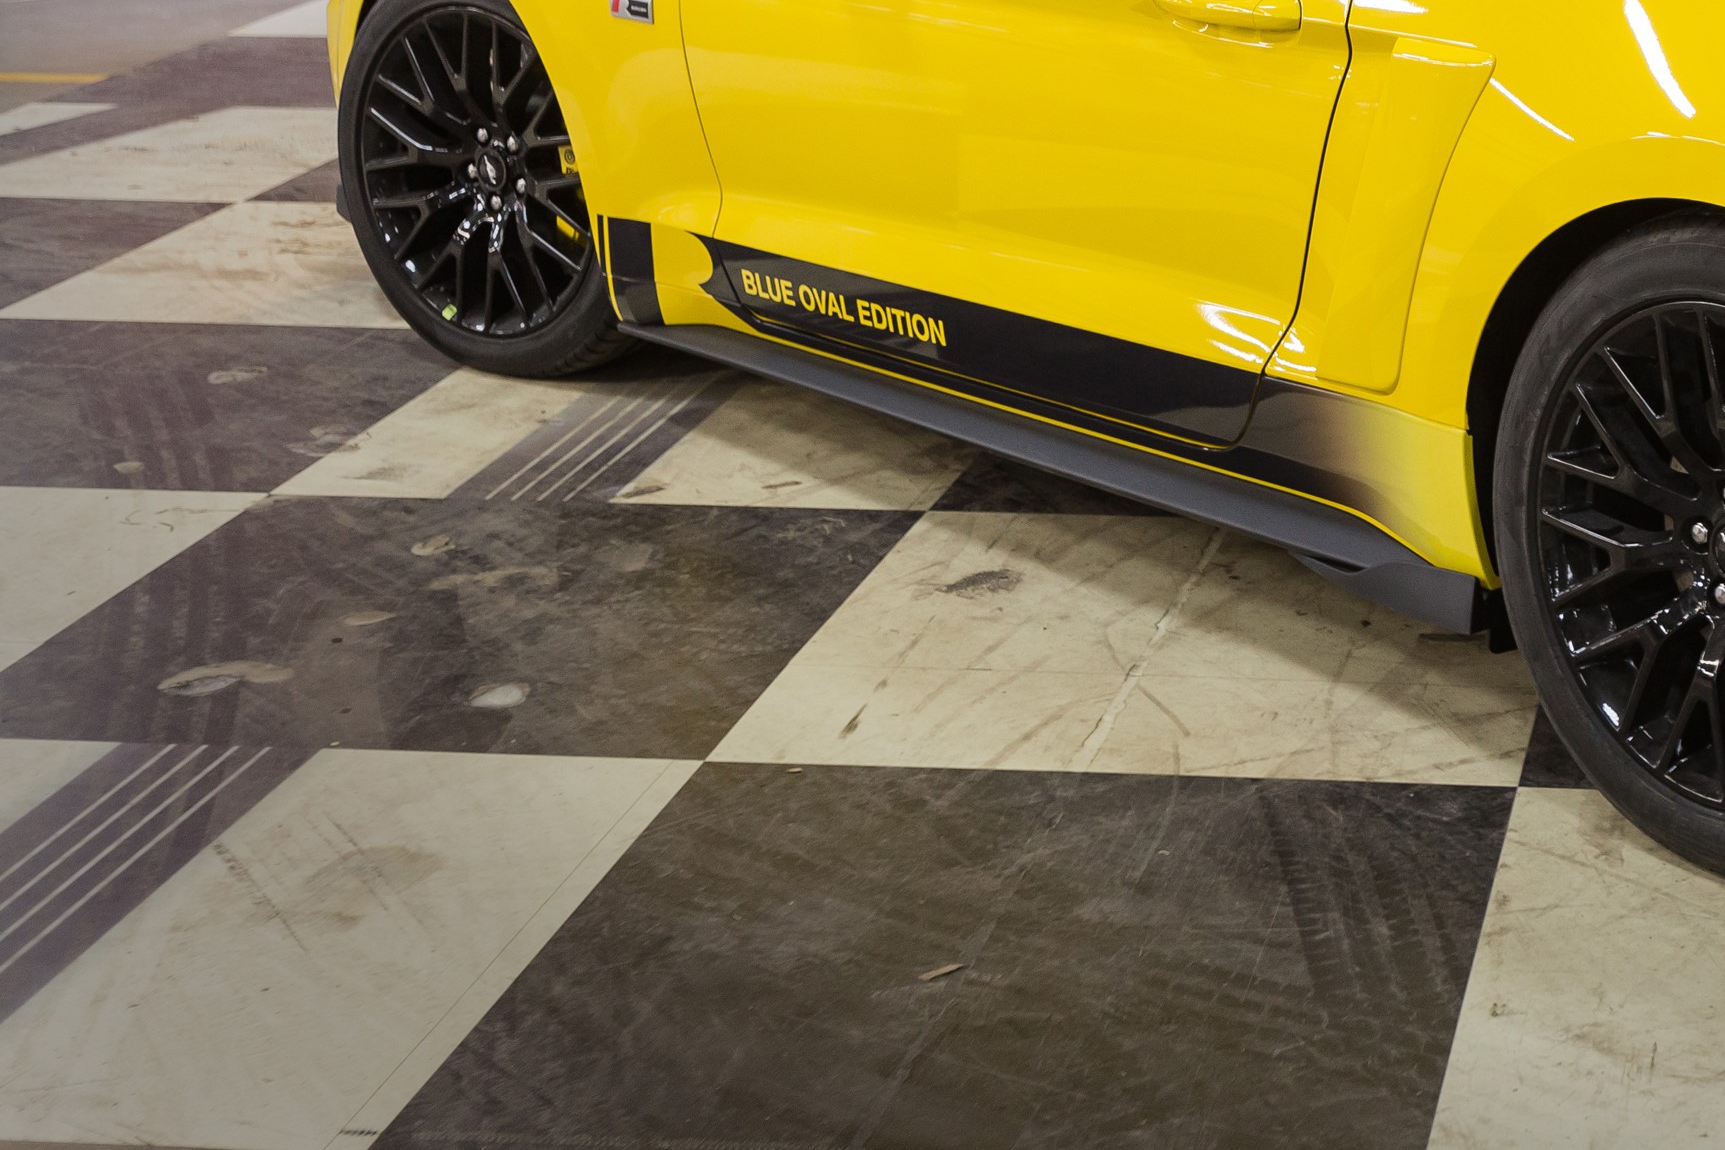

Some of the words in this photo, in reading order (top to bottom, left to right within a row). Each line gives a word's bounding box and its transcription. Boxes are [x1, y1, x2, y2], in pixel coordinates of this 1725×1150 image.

[741, 269, 796, 307] BLUE
[798, 284, 855, 322] OVAL
[856, 299, 947, 347] EDITION
